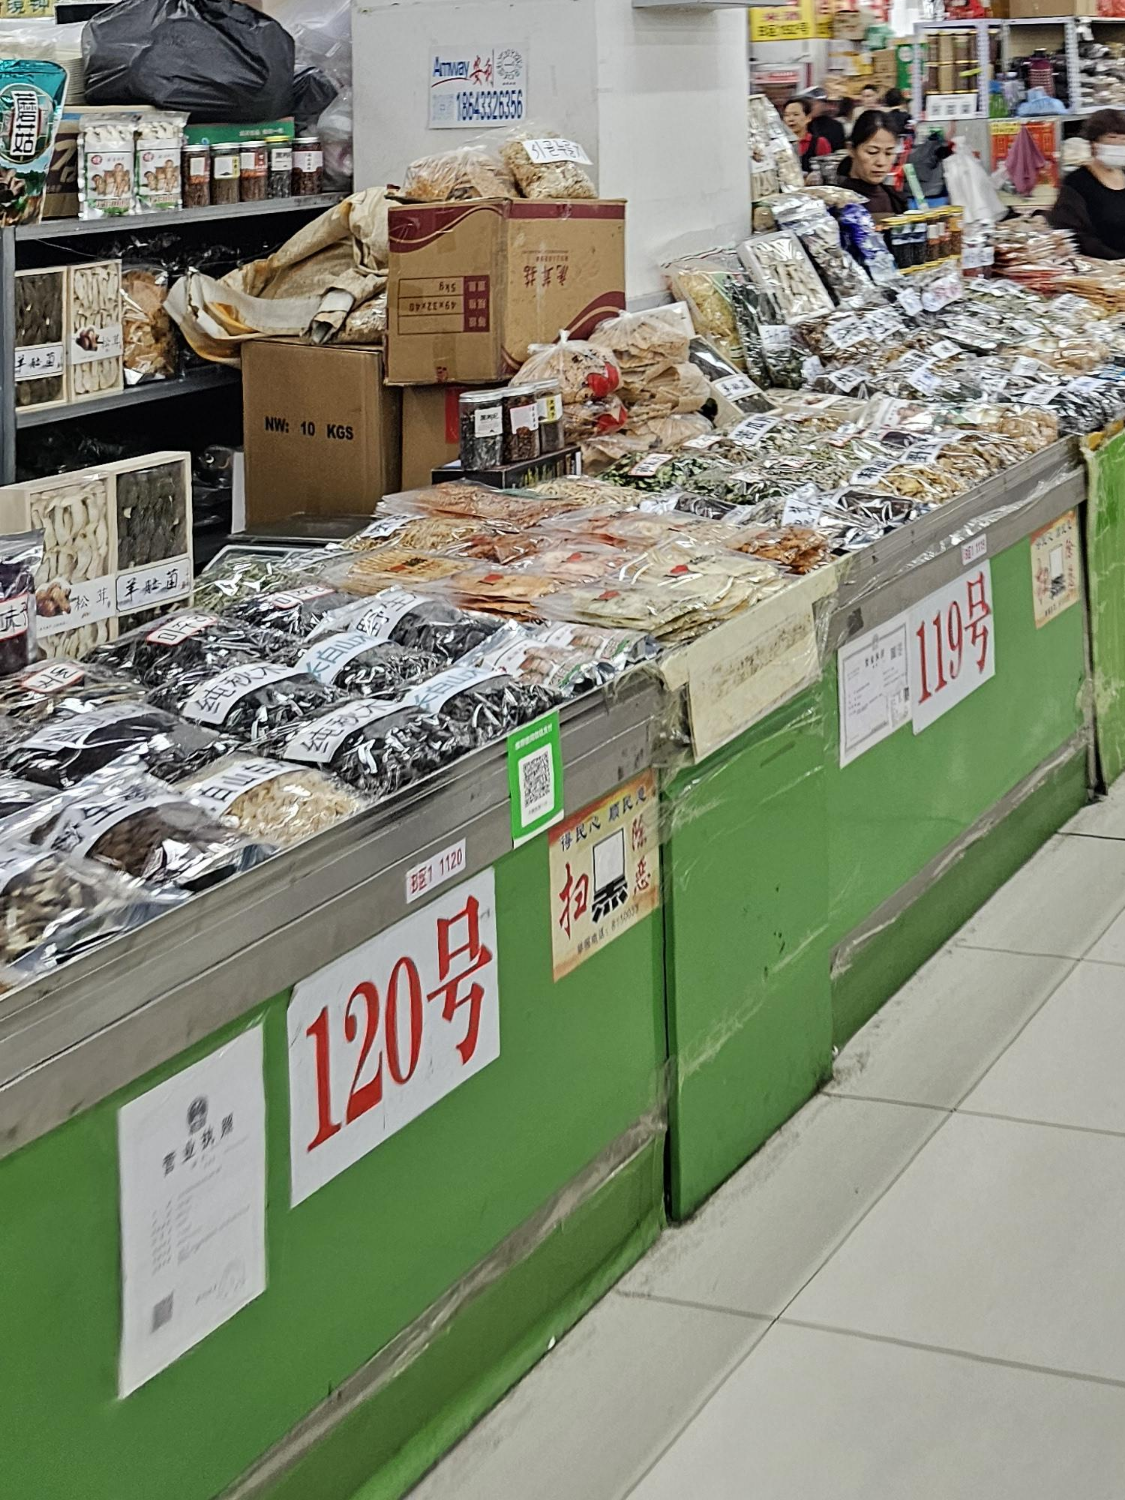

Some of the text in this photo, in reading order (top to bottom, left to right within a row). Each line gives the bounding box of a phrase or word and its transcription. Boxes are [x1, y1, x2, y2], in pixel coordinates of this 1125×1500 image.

[432, 56, 470, 77] Amway
[456, 88, 523, 121] 18643326356
[12, 91, 37, 155] 蘑菇
[438, 281, 458, 293] 5kg
[265, 415, 355, 441] NW: 10 KGS
[74, 587, 109, 612] 松茸
[125, 568, 180, 601] 羊肚菌
[917, 571, 992, 706] 119号
[439, 847, 463, 878] 1120
[559, 862, 589, 940] 扫
[306, 894, 493, 1154] 120号
